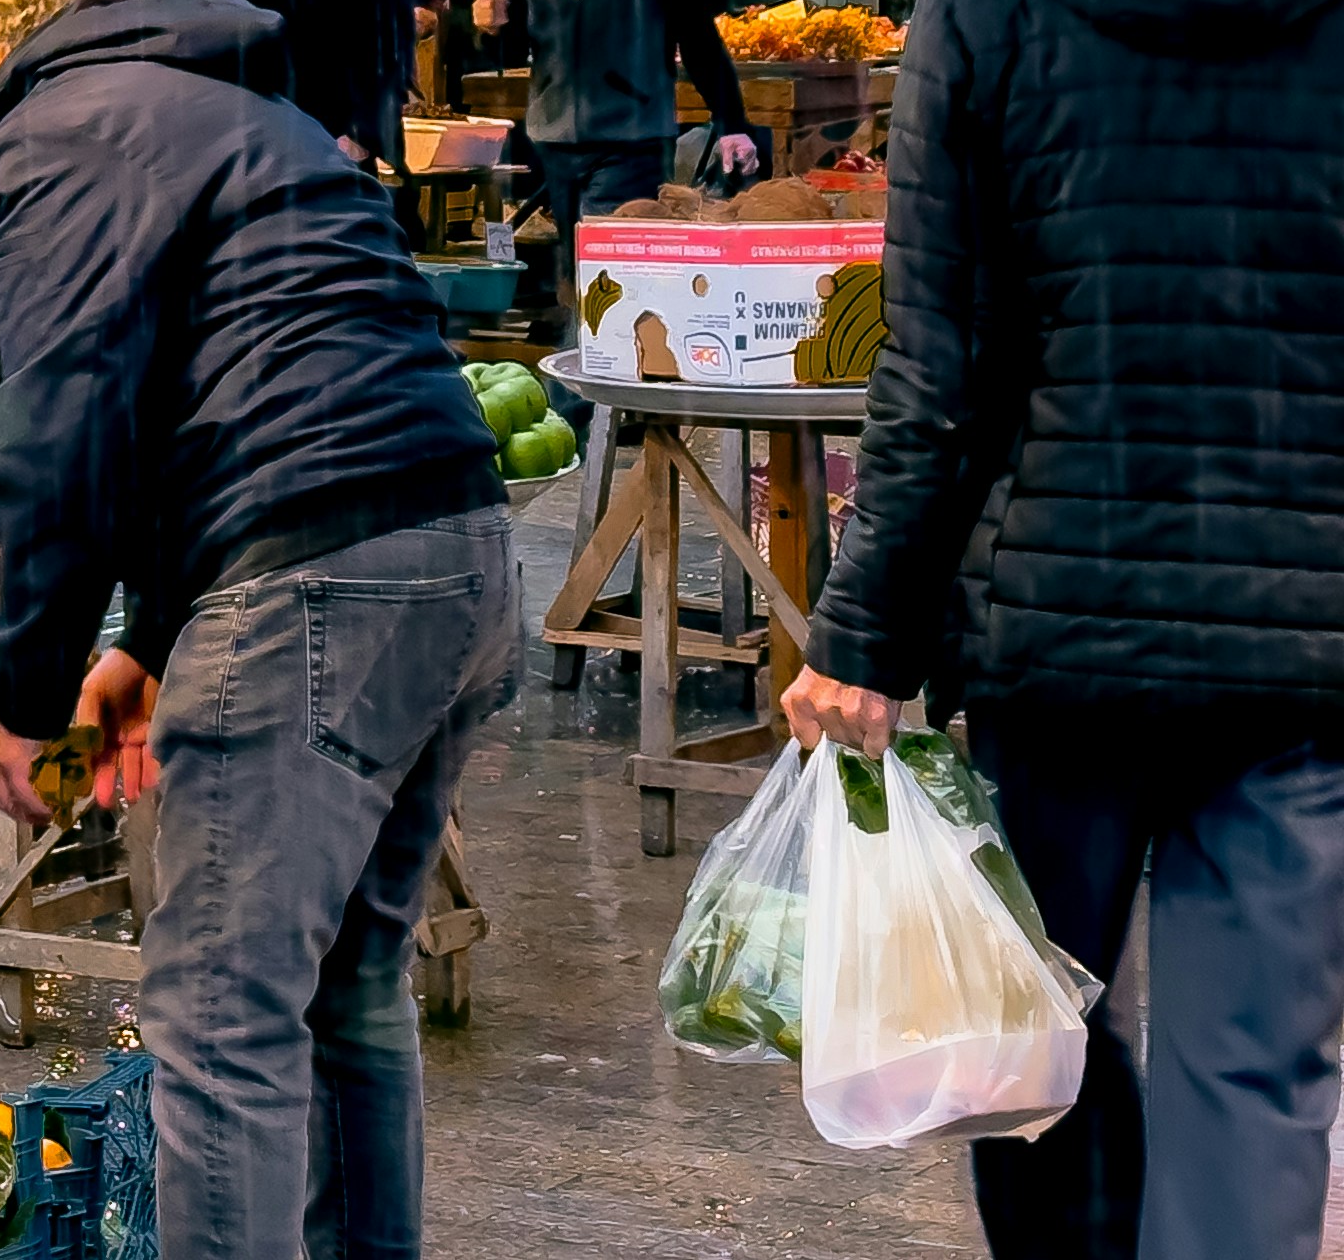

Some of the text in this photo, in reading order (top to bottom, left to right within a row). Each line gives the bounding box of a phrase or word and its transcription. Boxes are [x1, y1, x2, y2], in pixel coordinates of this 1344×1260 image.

[753, 301, 828, 320] BANANAS
[754, 322, 826, 340] PREMIUM
[691, 347, 721, 367] Dole
